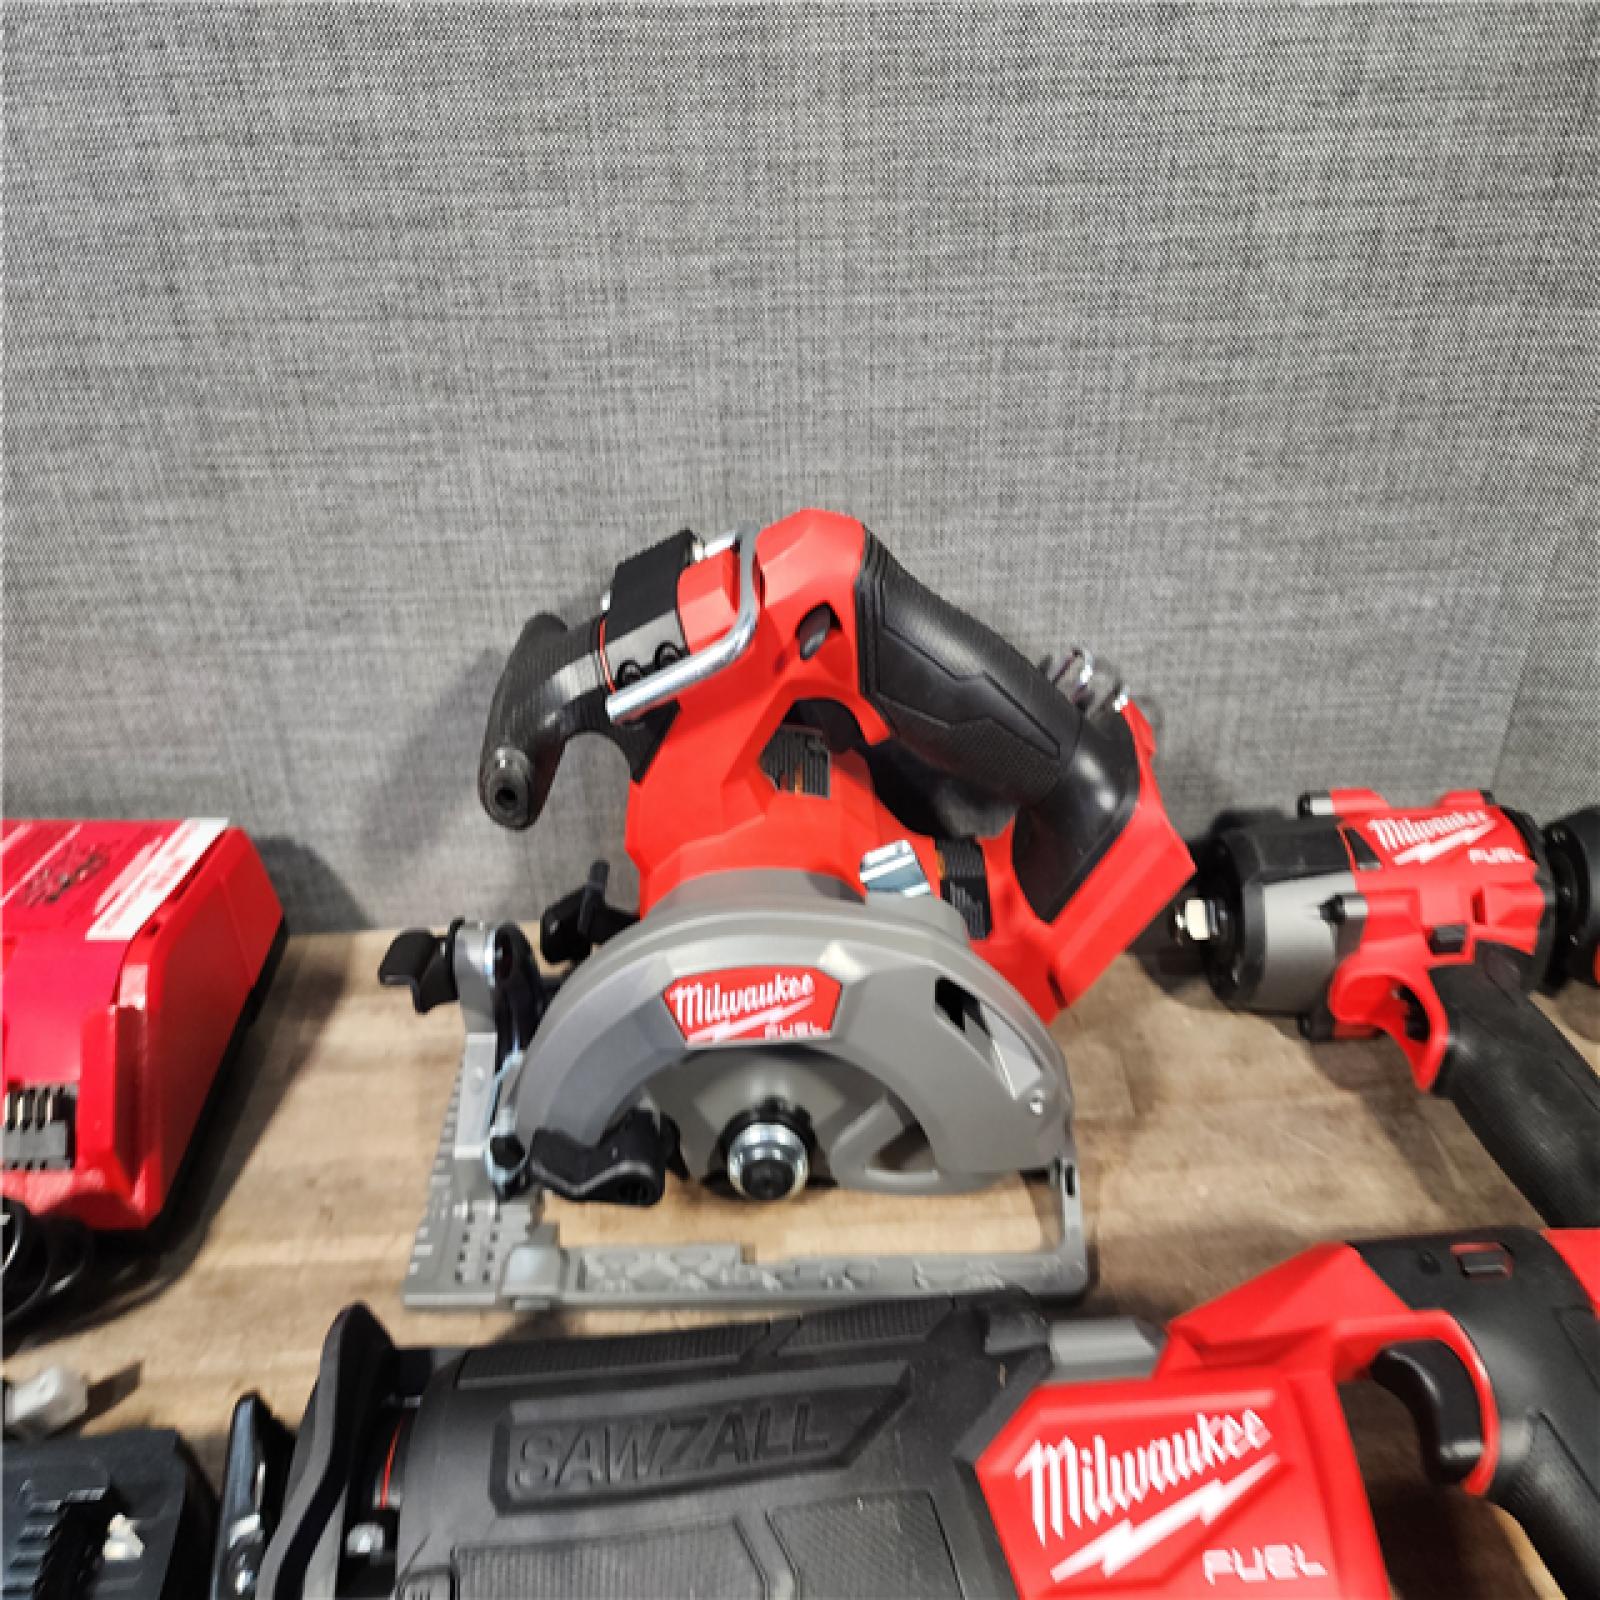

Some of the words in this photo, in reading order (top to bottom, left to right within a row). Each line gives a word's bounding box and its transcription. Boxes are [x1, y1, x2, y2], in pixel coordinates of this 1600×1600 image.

[669, 972, 815, 1028] Milwaukee
[514, 1402, 829, 1492] SAWZALL
[1014, 1408, 1272, 1547] Milwaukee
[1202, 1543, 1328, 1586] FUEL
